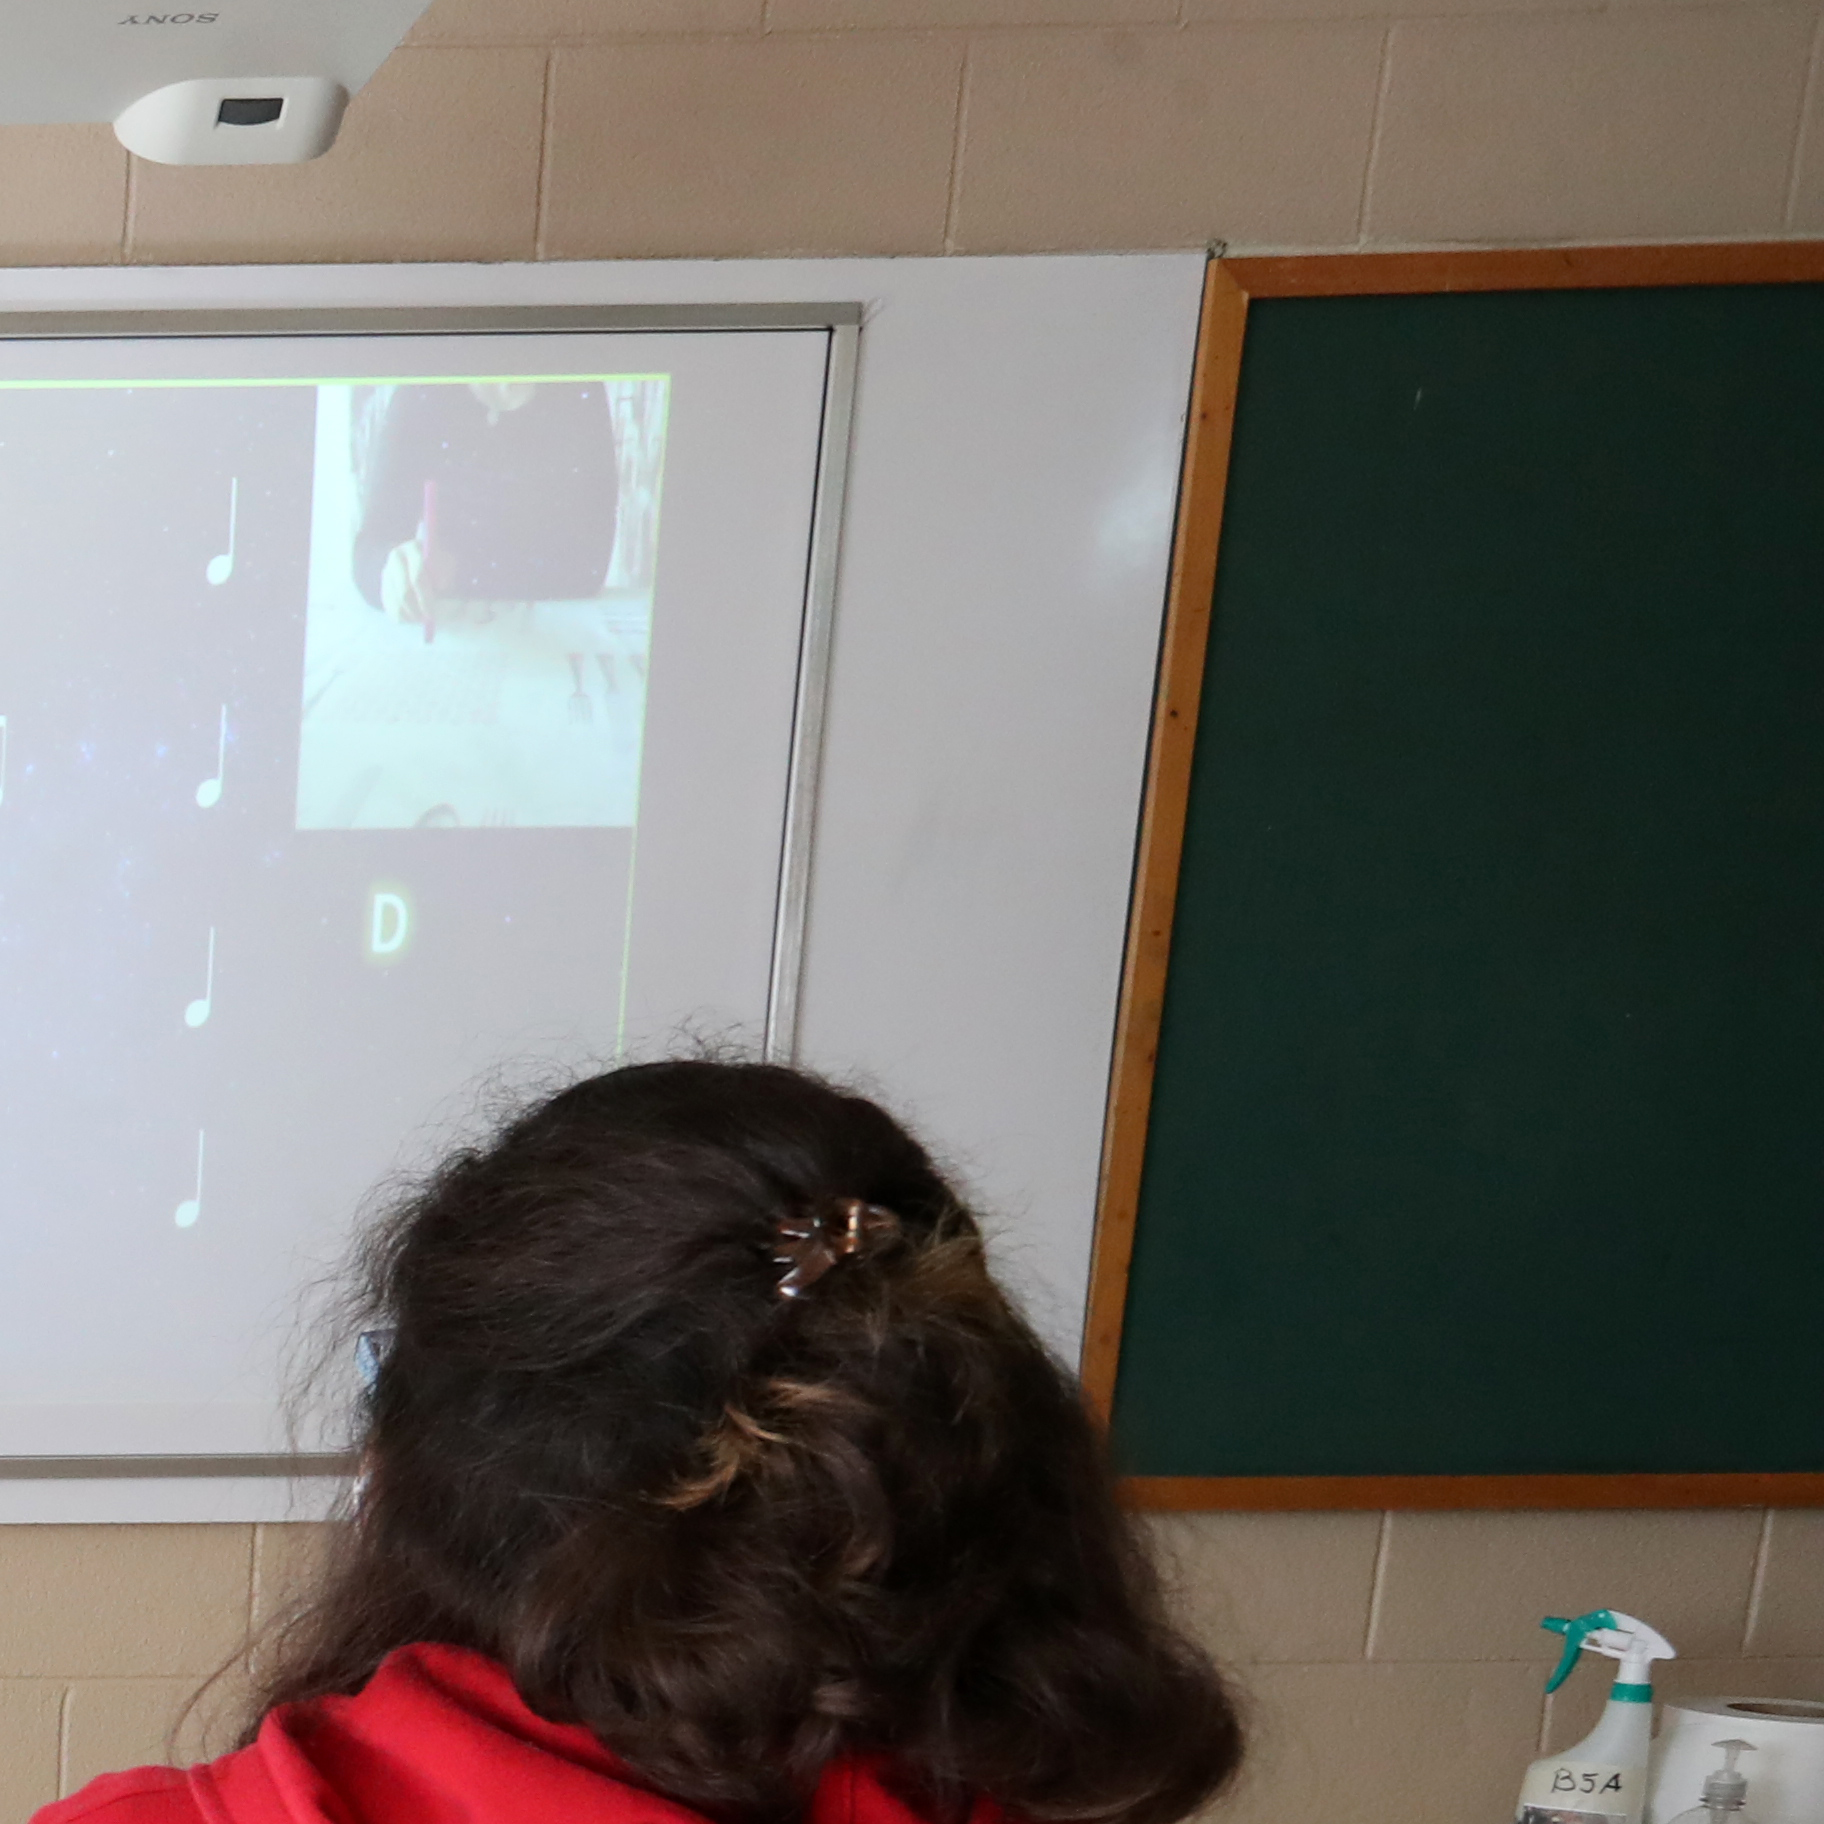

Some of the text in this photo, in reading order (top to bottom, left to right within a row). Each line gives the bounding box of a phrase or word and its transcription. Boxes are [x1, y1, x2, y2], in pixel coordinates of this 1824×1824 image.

[117, 12, 221, 27] SONY
[370, 890, 409, 956] D
[1550, 1767, 1624, 1795] B5A
